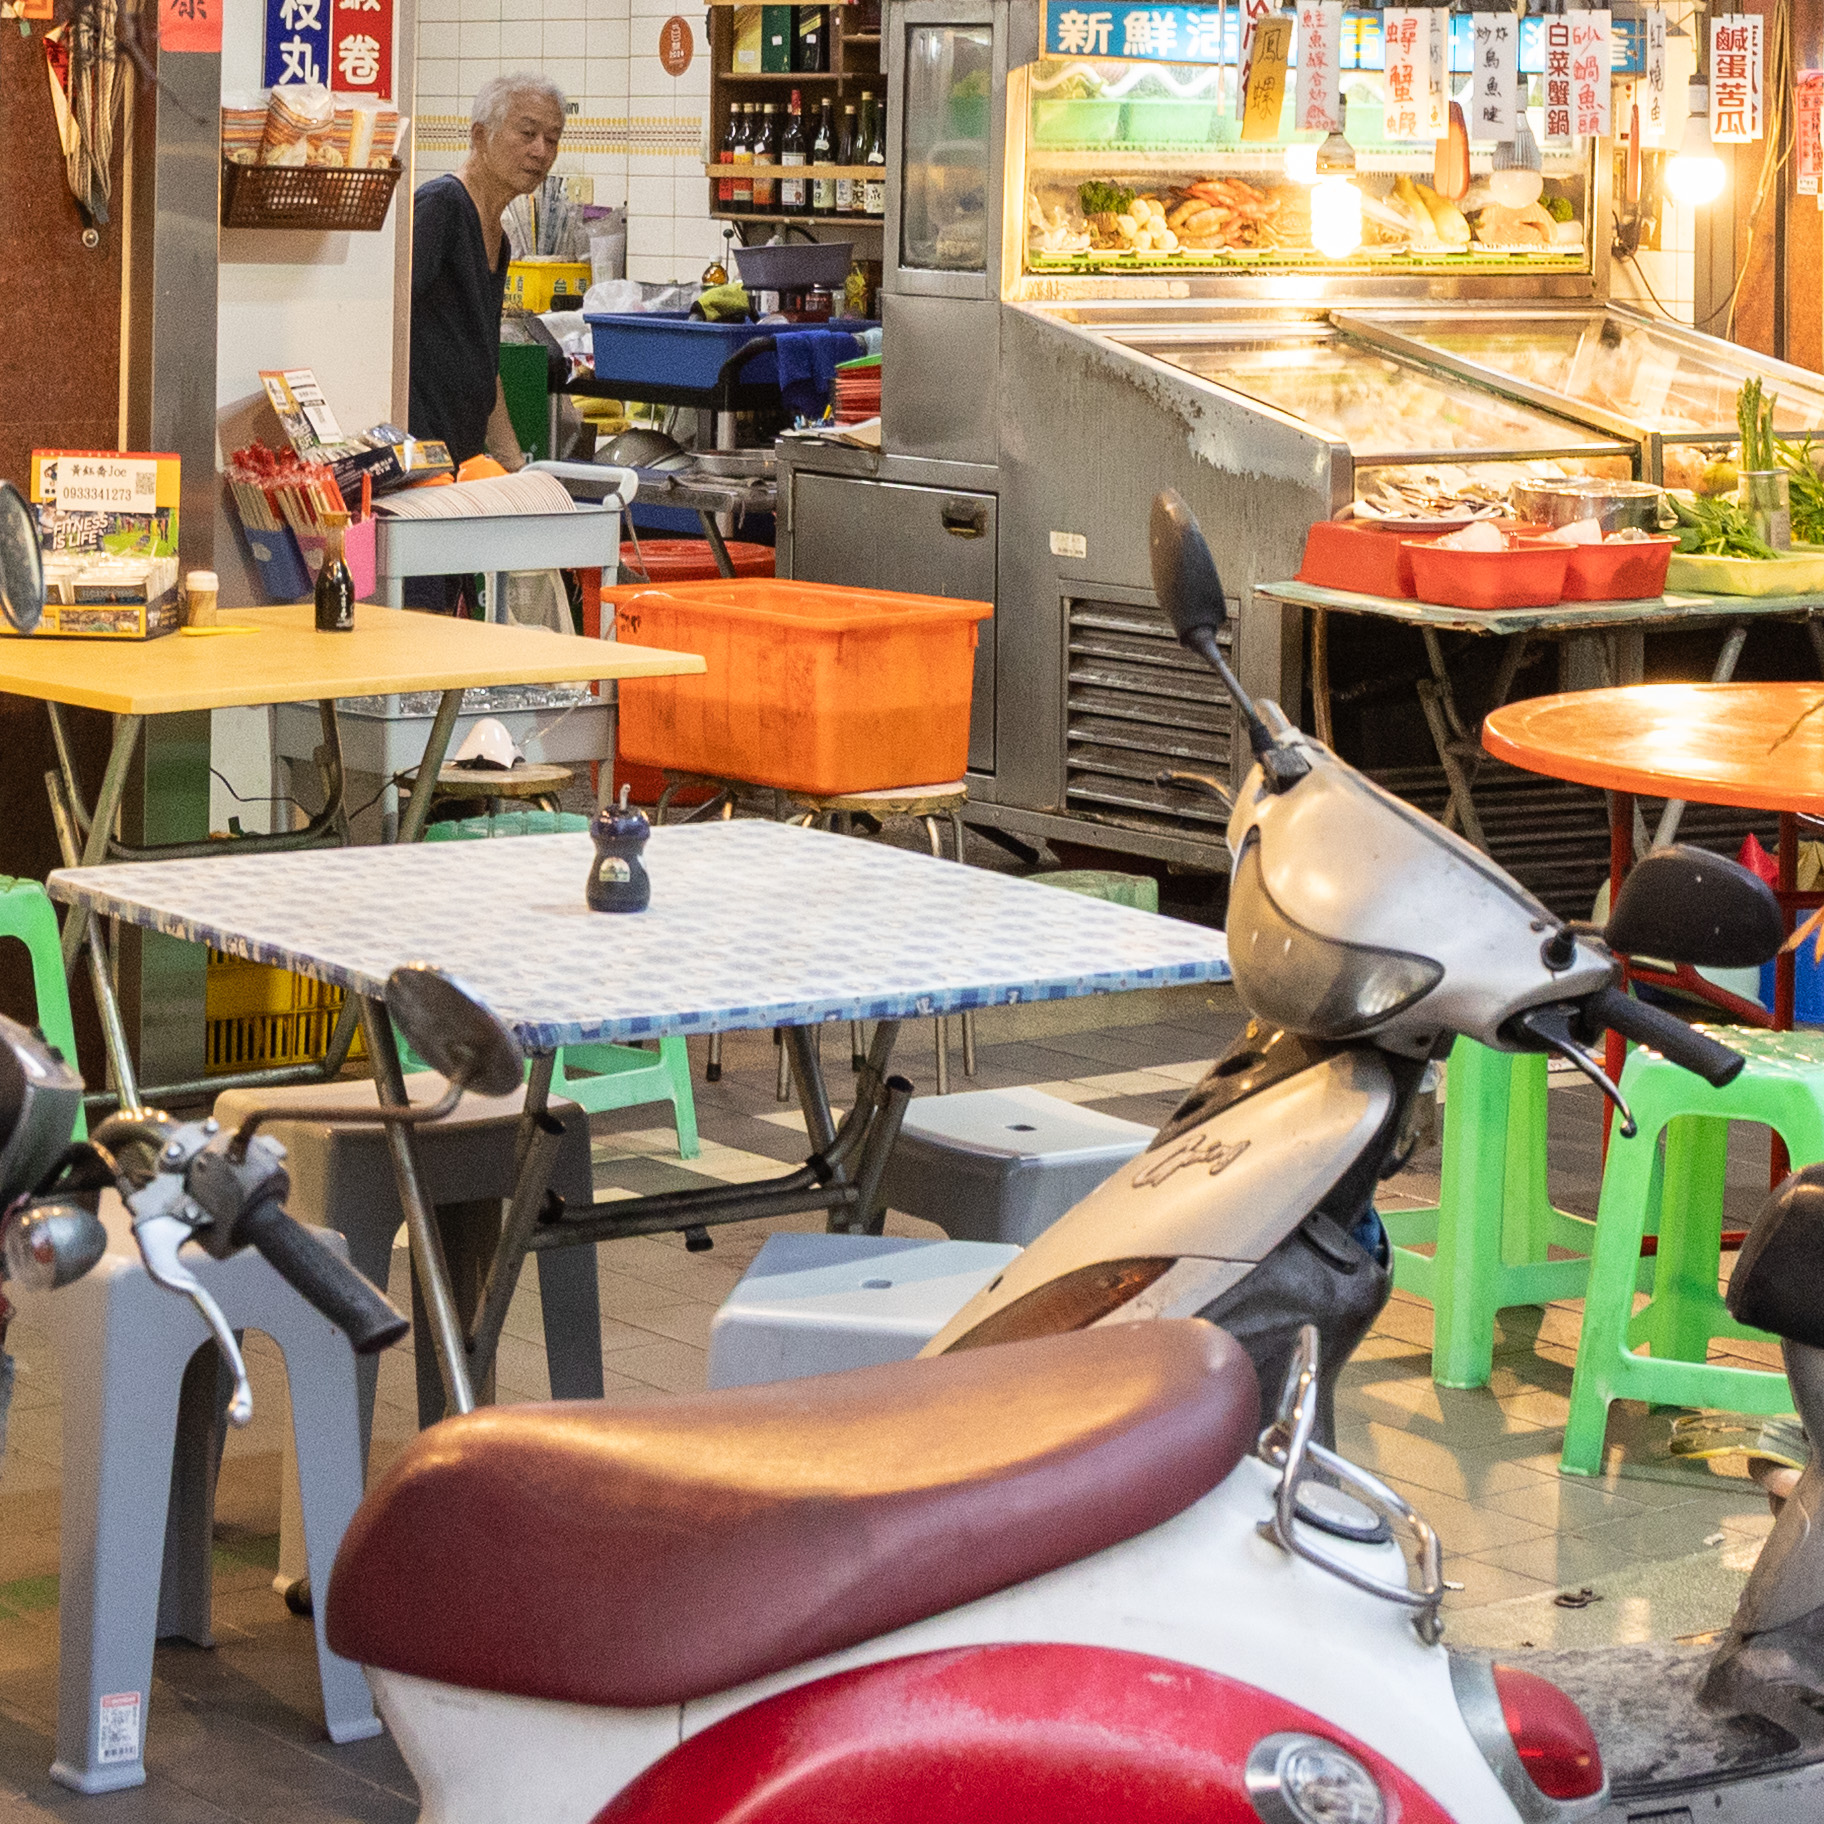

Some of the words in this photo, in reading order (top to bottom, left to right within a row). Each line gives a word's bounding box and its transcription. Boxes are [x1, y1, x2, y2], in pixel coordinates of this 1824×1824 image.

[1546, 22, 1571, 137] 白菜蟹鍋
[1714, 26, 1750, 135] 鹹蛋苦瓜
[62, 487, 132, 502] 0933341273
[53, 514, 109, 537] FITNESS
[52, 534, 66, 550] IS
[68, 529, 99, 548] LIFE
